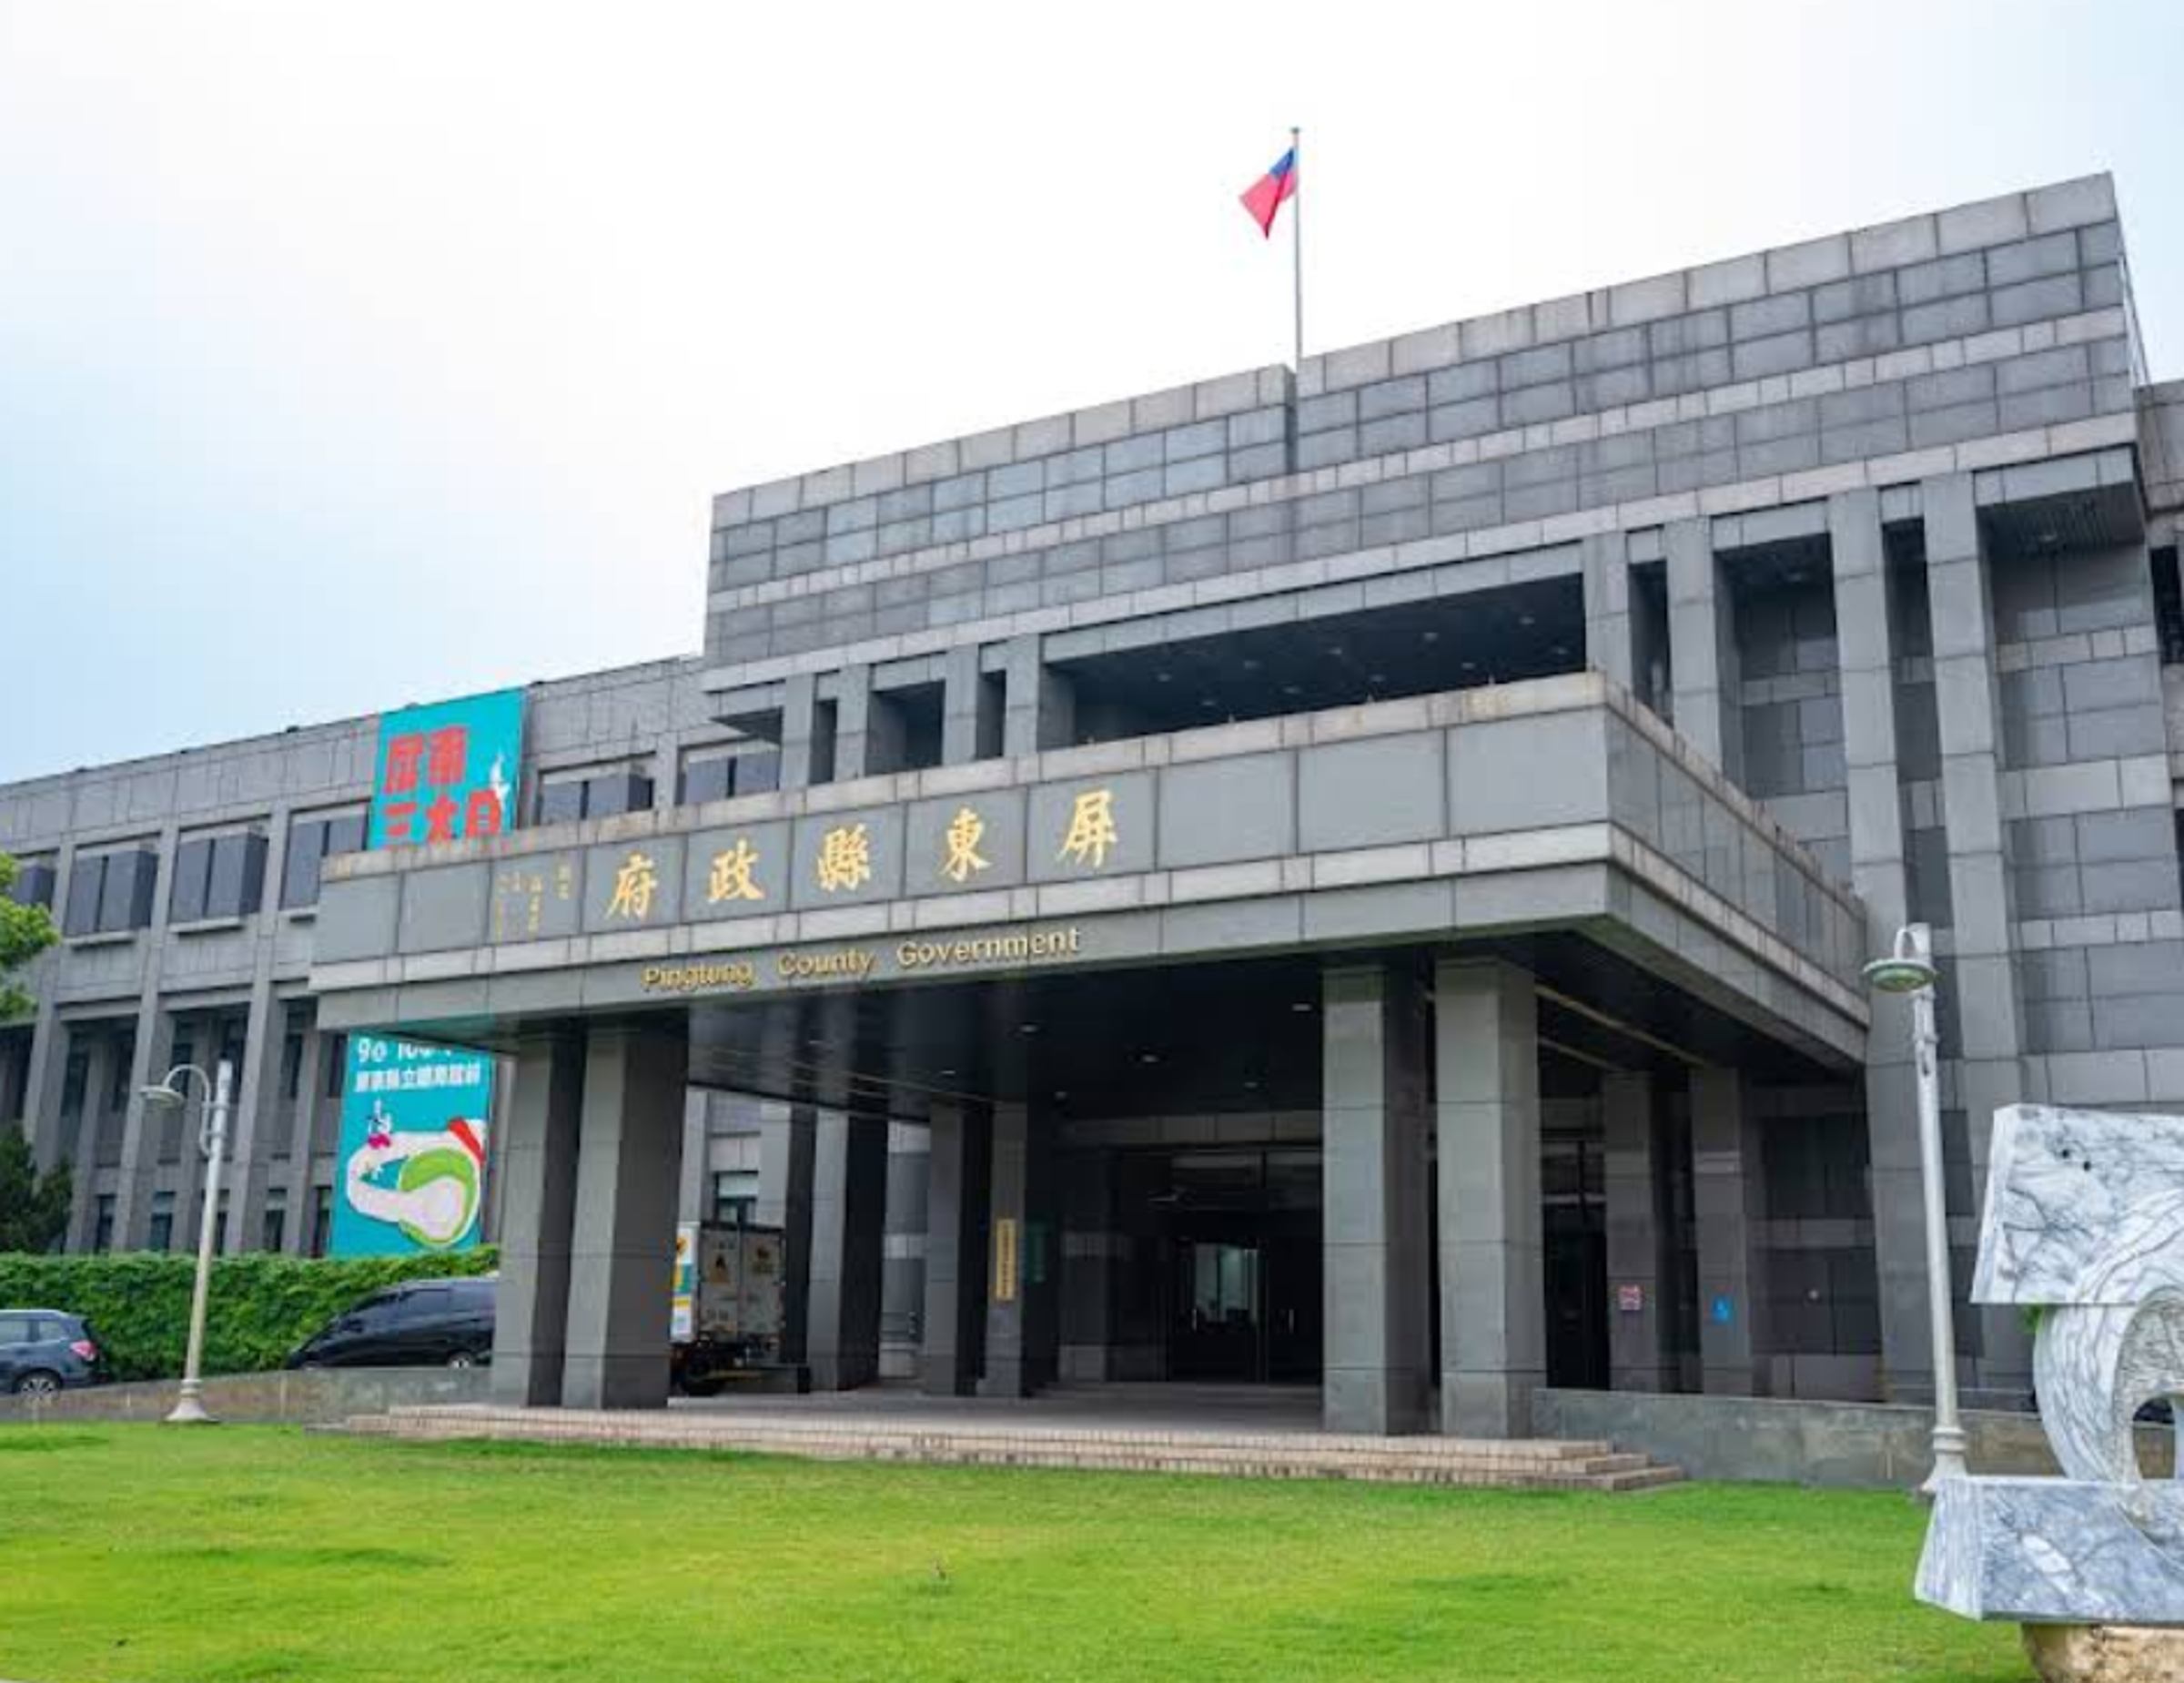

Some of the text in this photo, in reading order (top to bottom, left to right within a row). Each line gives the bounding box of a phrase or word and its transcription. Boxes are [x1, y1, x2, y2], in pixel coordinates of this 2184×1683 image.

[642, 926, 1081, 989] Pingtung County Government
